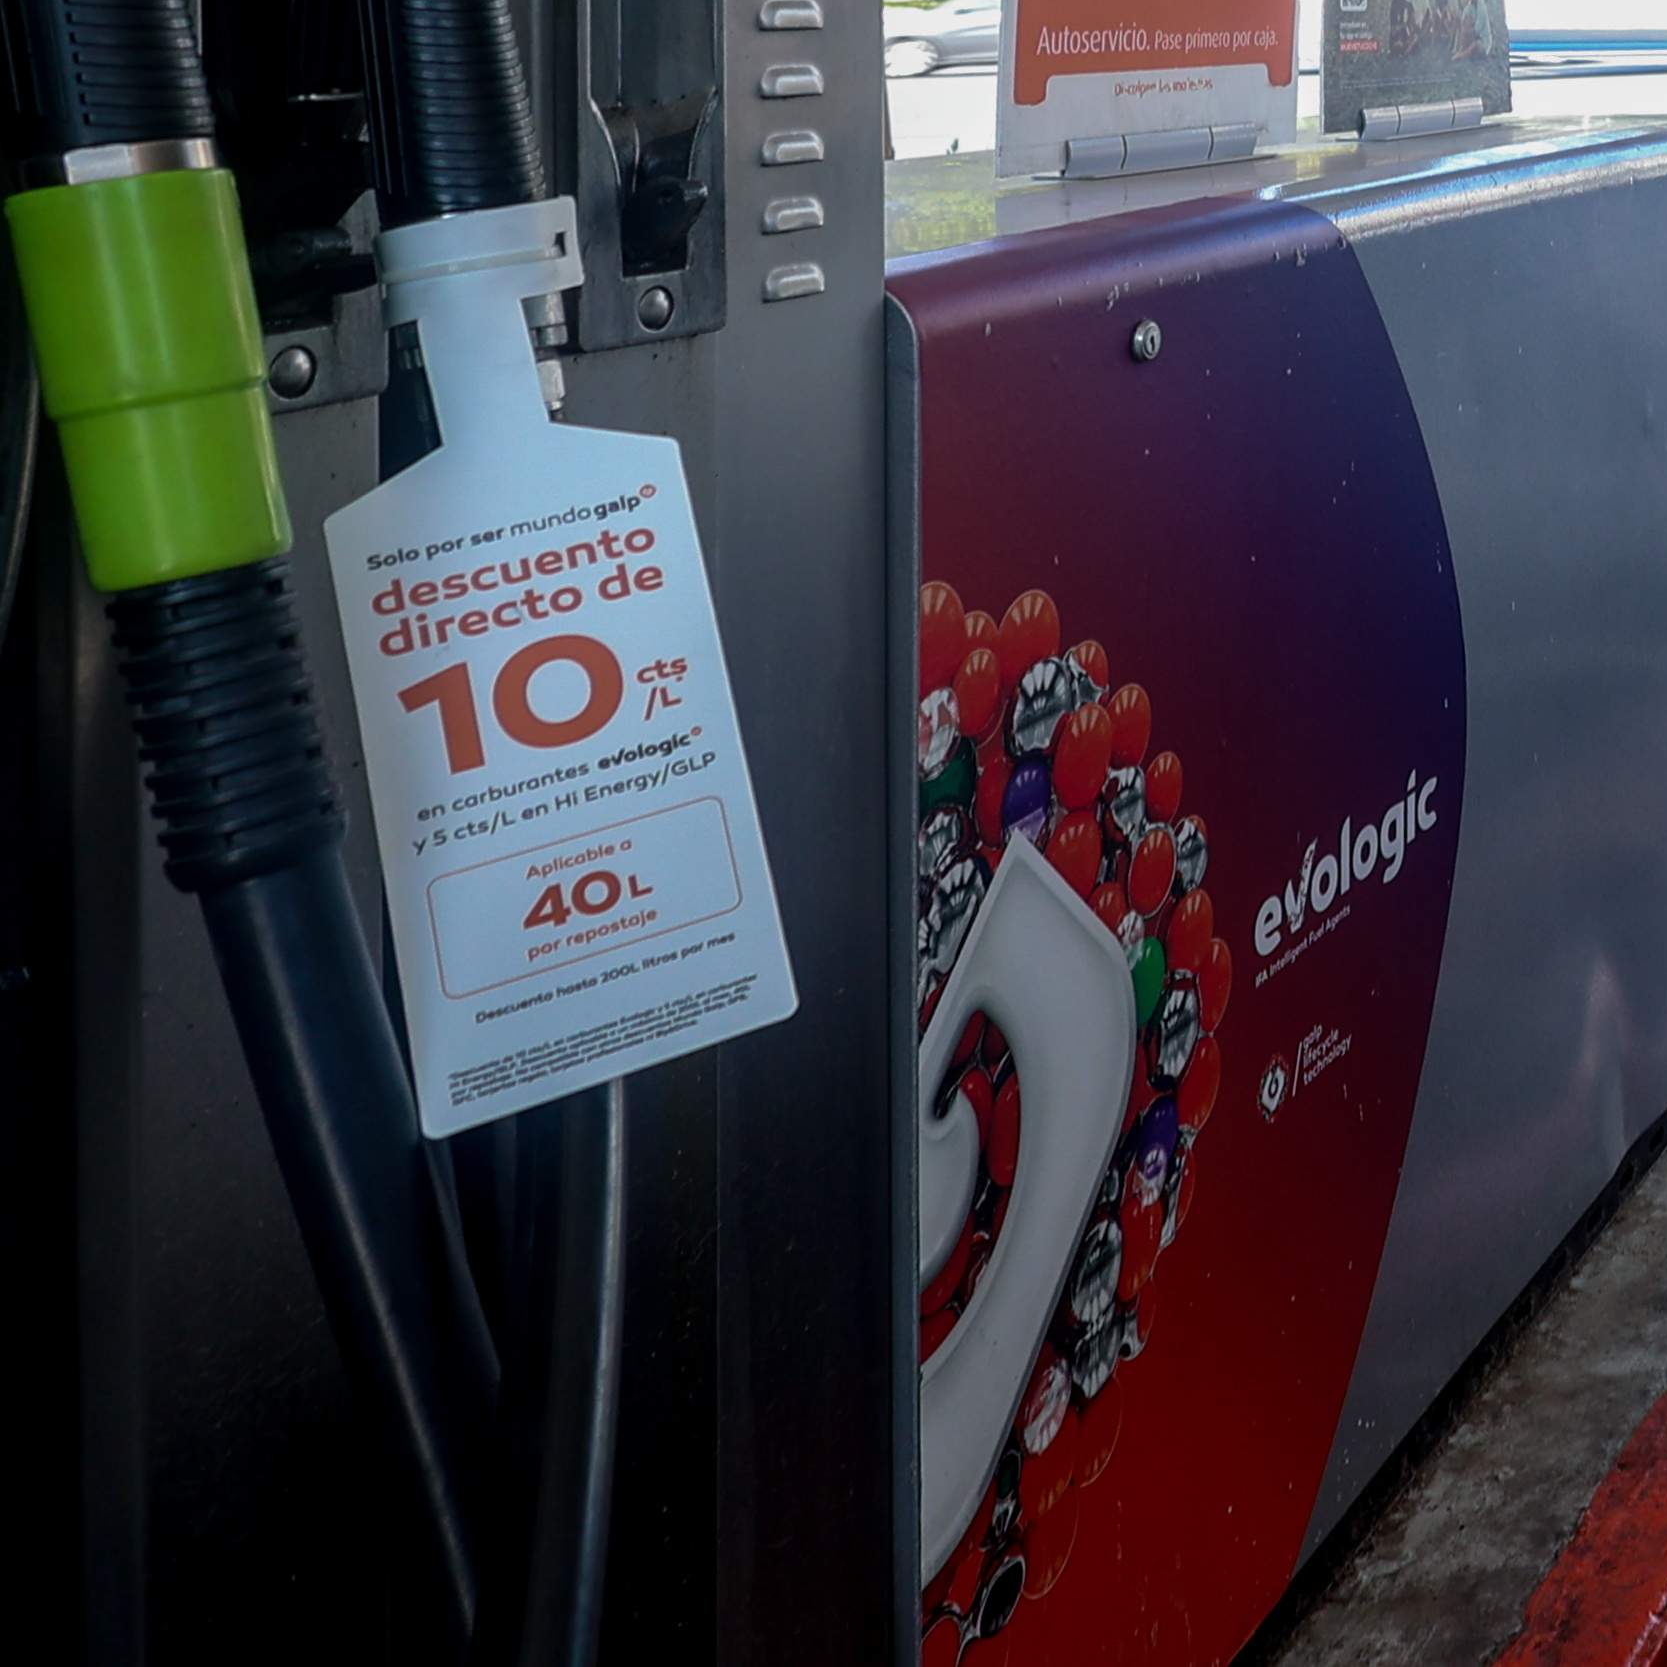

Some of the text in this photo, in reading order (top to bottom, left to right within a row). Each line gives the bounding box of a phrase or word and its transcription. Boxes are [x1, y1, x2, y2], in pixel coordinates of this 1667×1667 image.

[1037, 22, 1279, 56] Autoservicio. Pase primero por caja.
[367, 494, 641, 571] Solo por ser mundogalp
[371, 528, 656, 616] descuento
[379, 562, 664, 656] directo de
[397, 633, 625, 776] 10
[636, 656, 688, 684] cts
[643, 686, 682, 721] /L
[412, 750, 717, 856] y 5 cts/L en Hi Energy/GLP
[417, 731, 692, 822] en carburantes evologic
[525, 838, 633, 881] Aplicable a
[1254, 767, 1438, 957] evologic
[527, 907, 658, 963] por repostaje
[1255, 904, 1351, 989] IFA Intelligent Fuel Agents
[475, 932, 736, 1025] Descuento hasta 200L litros por mes
[1302, 1023, 1323, 1049] galp
[1302, 1029, 1340, 1069] lifecycle
[1303, 1033, 1351, 1085] technology
